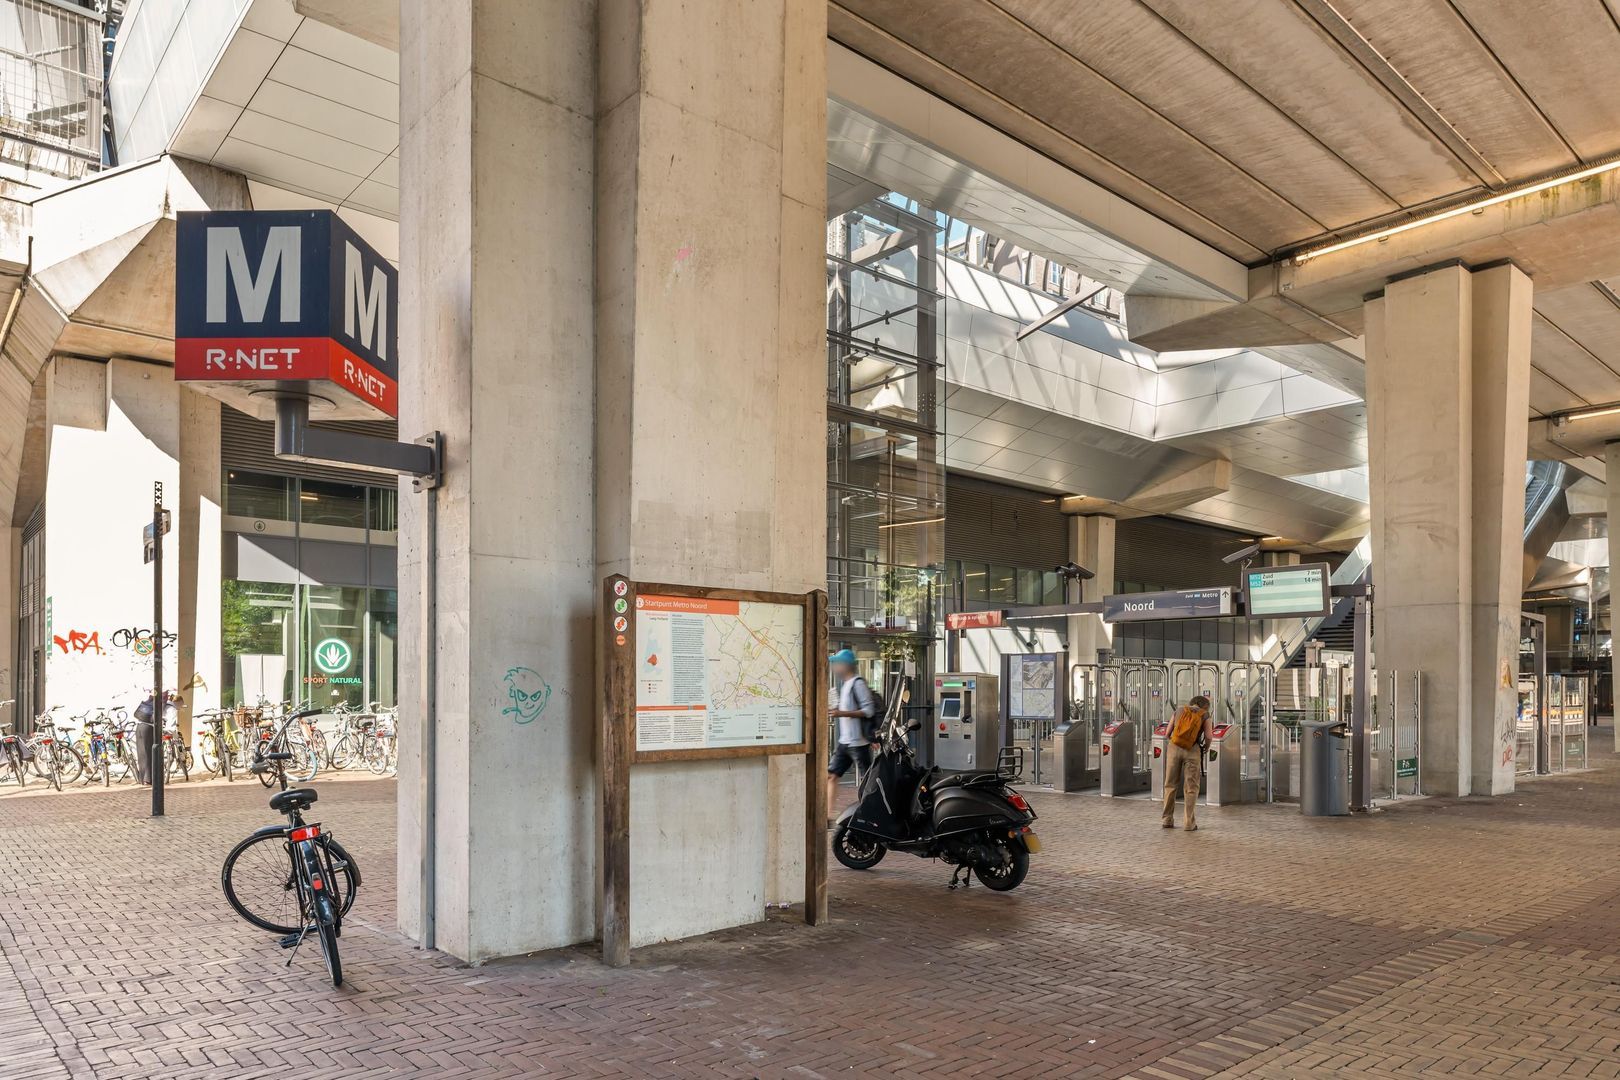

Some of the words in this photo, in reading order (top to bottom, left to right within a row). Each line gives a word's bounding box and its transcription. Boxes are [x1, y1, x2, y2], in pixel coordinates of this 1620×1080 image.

[206, 226, 302, 323] M
[344, 239, 388, 362] M
[645, 600, 671, 609] Startpunt
[673, 601, 689, 609] Metro
[1124, 600, 1155, 612] Noord
